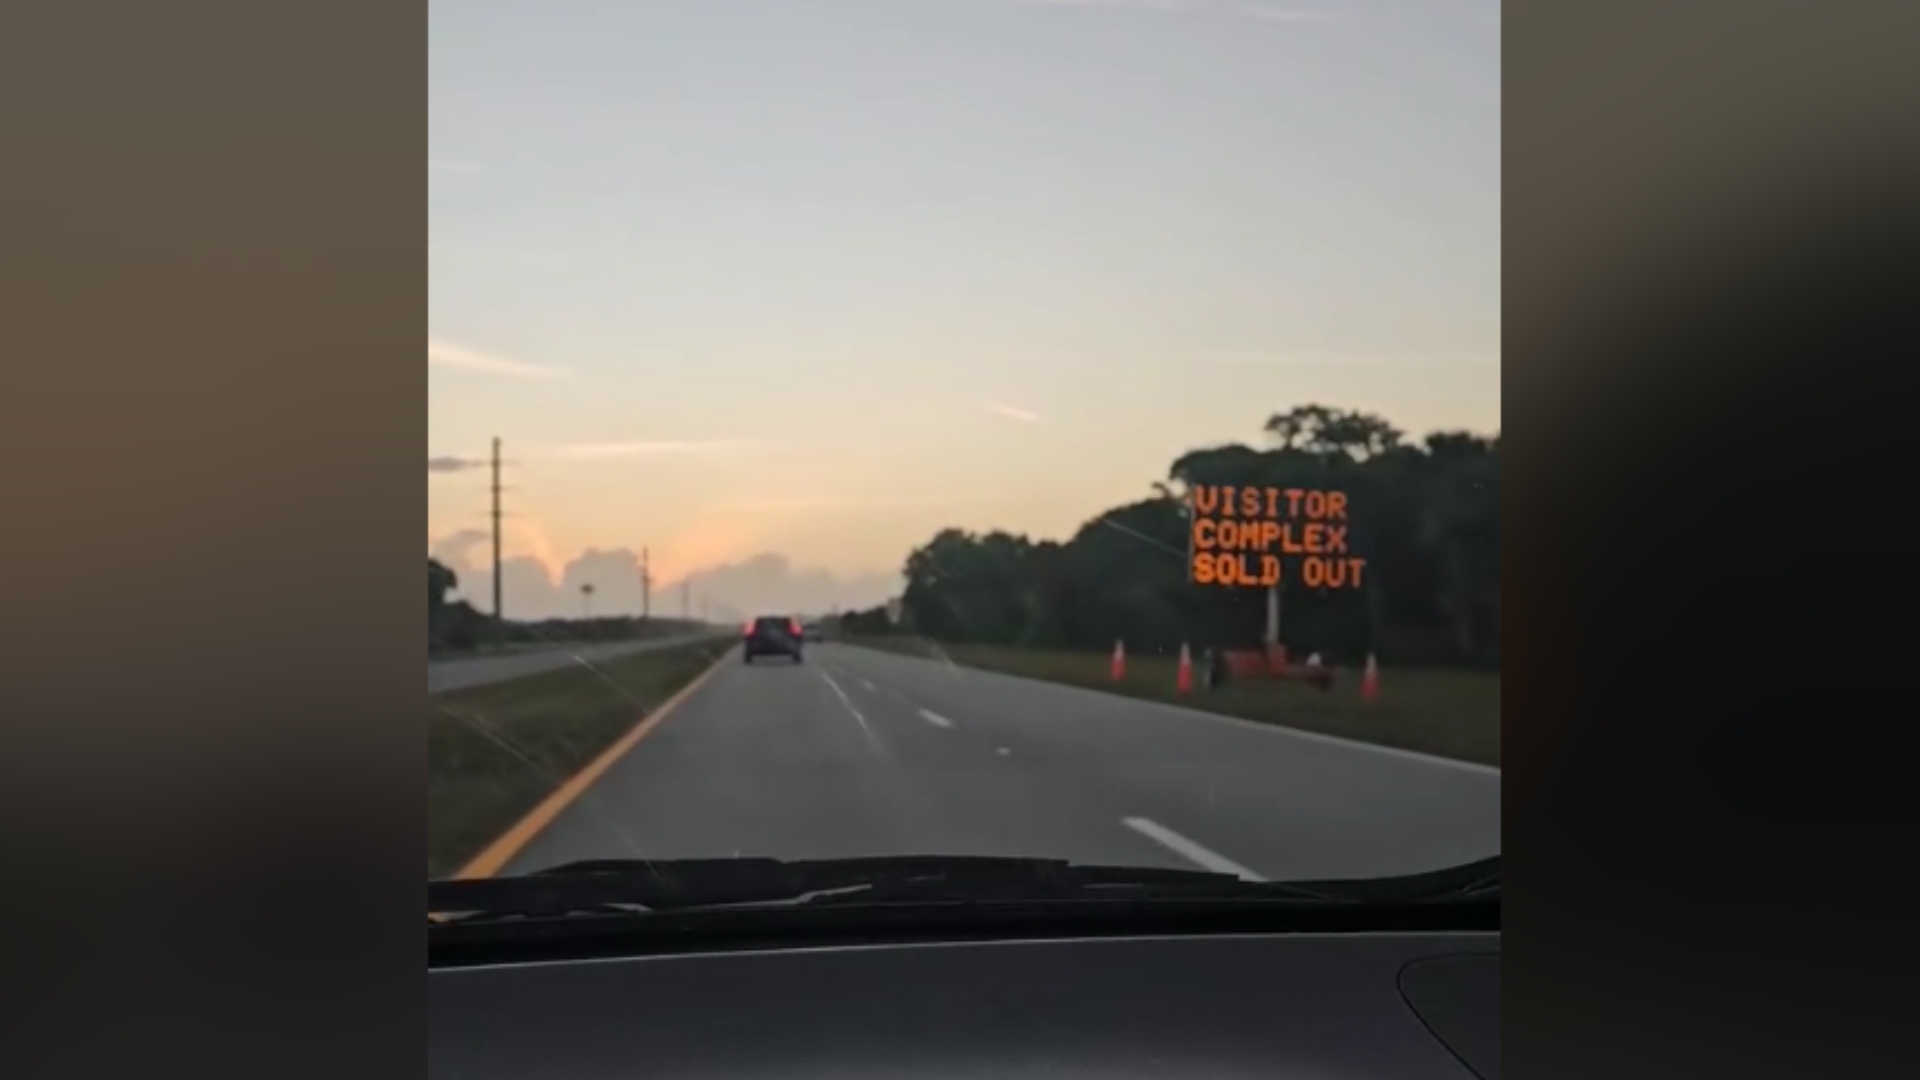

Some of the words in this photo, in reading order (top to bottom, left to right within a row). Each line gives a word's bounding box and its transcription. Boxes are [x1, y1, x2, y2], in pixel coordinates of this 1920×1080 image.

[1195, 486, 1347, 518] VISITOR
[1194, 518, 1347, 553] COMPLEX
[1194, 552, 1280, 585] SOLD
[1304, 556, 1366, 588] OUT
